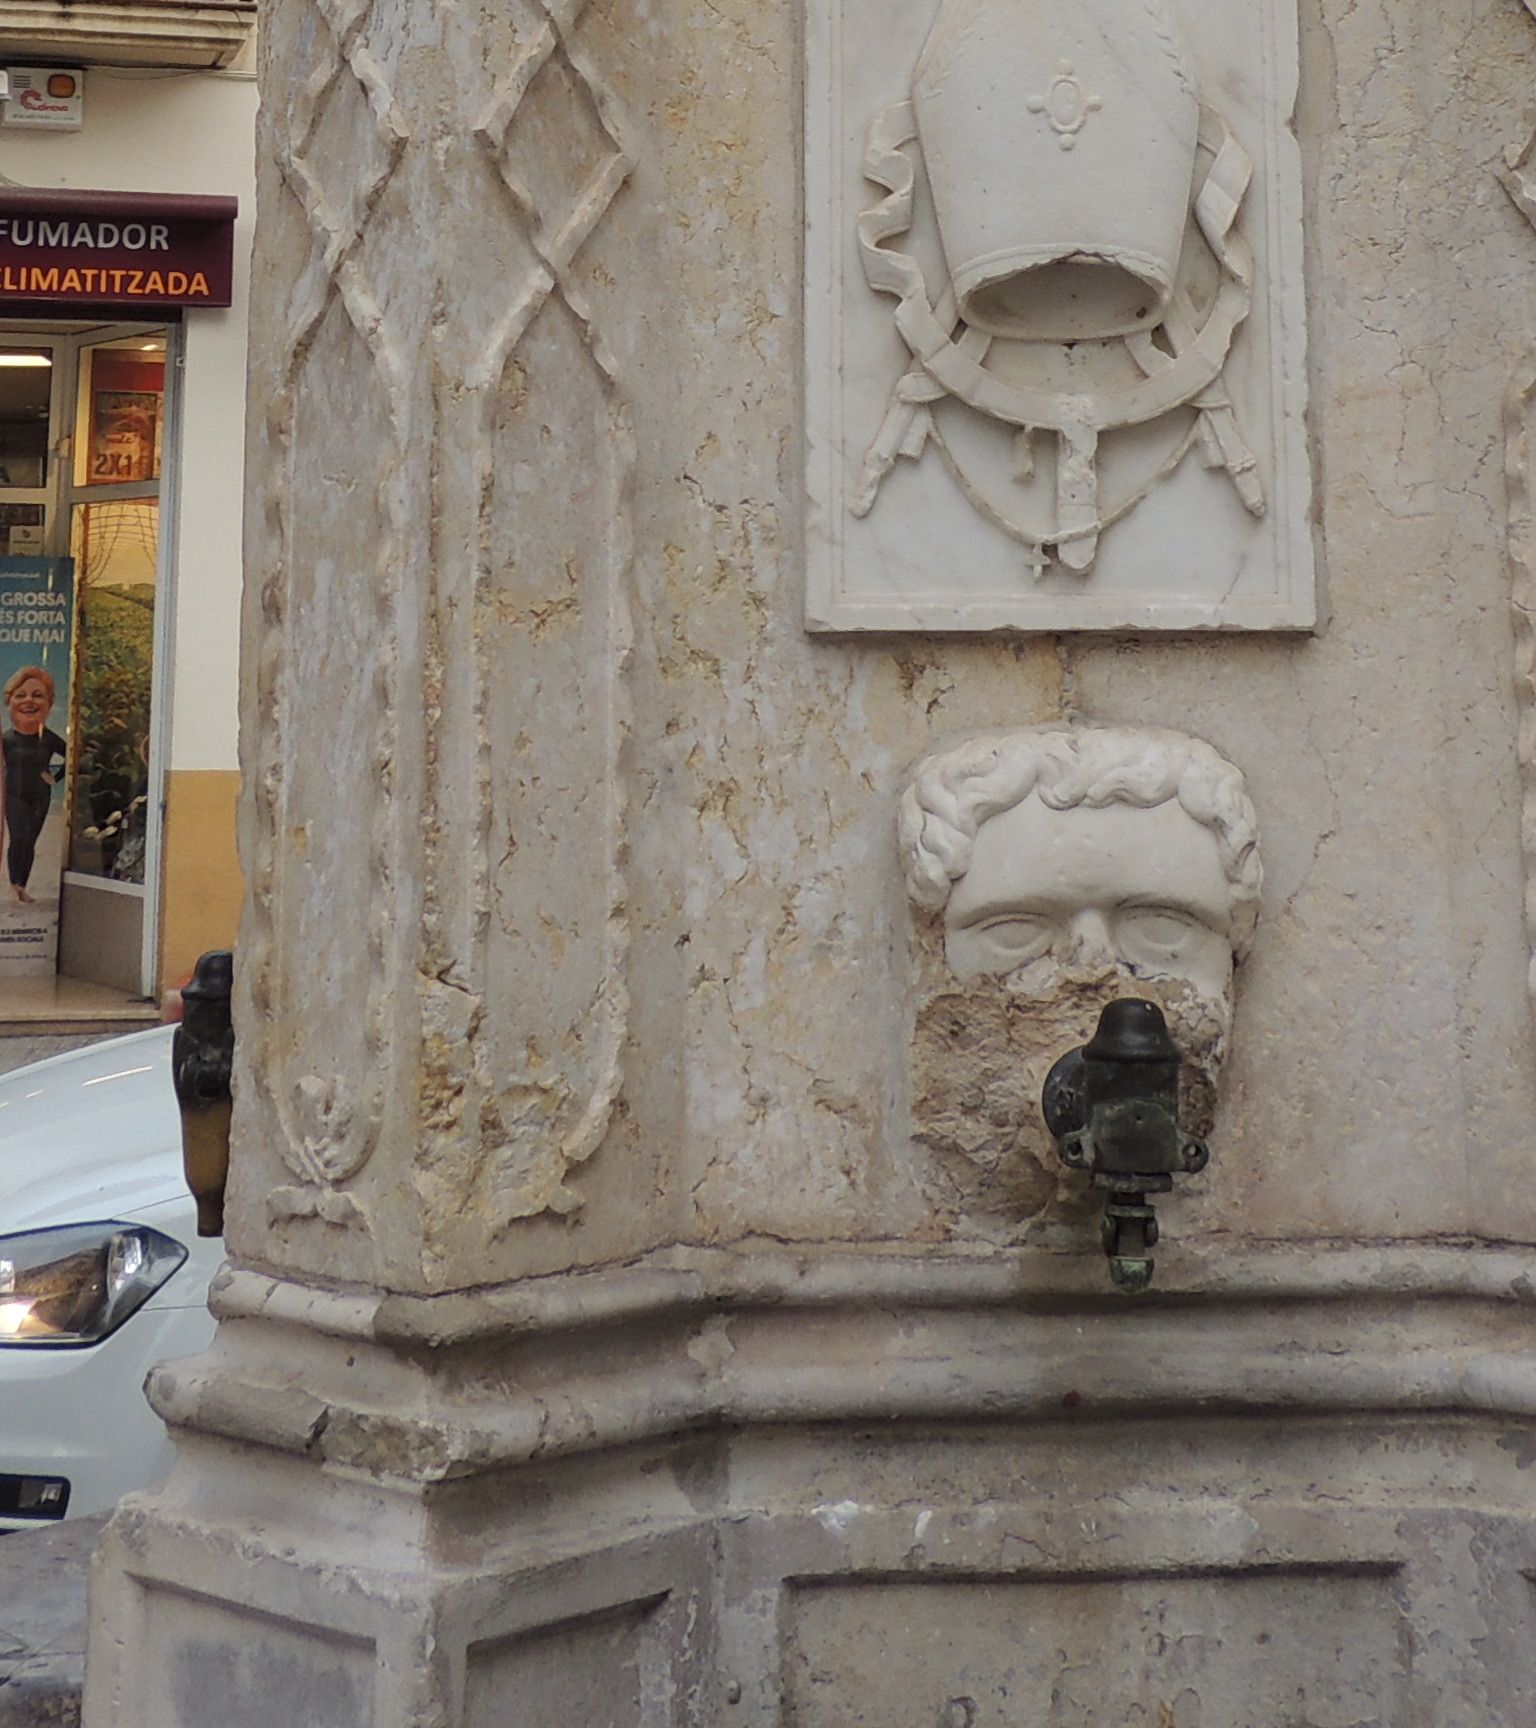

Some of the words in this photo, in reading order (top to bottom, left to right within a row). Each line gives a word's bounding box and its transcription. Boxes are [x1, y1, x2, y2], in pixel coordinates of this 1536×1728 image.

[0, 591, 67, 607] GROSSA
[16, 610, 66, 625] FORTA
[32, 628, 65, 643] MAI
